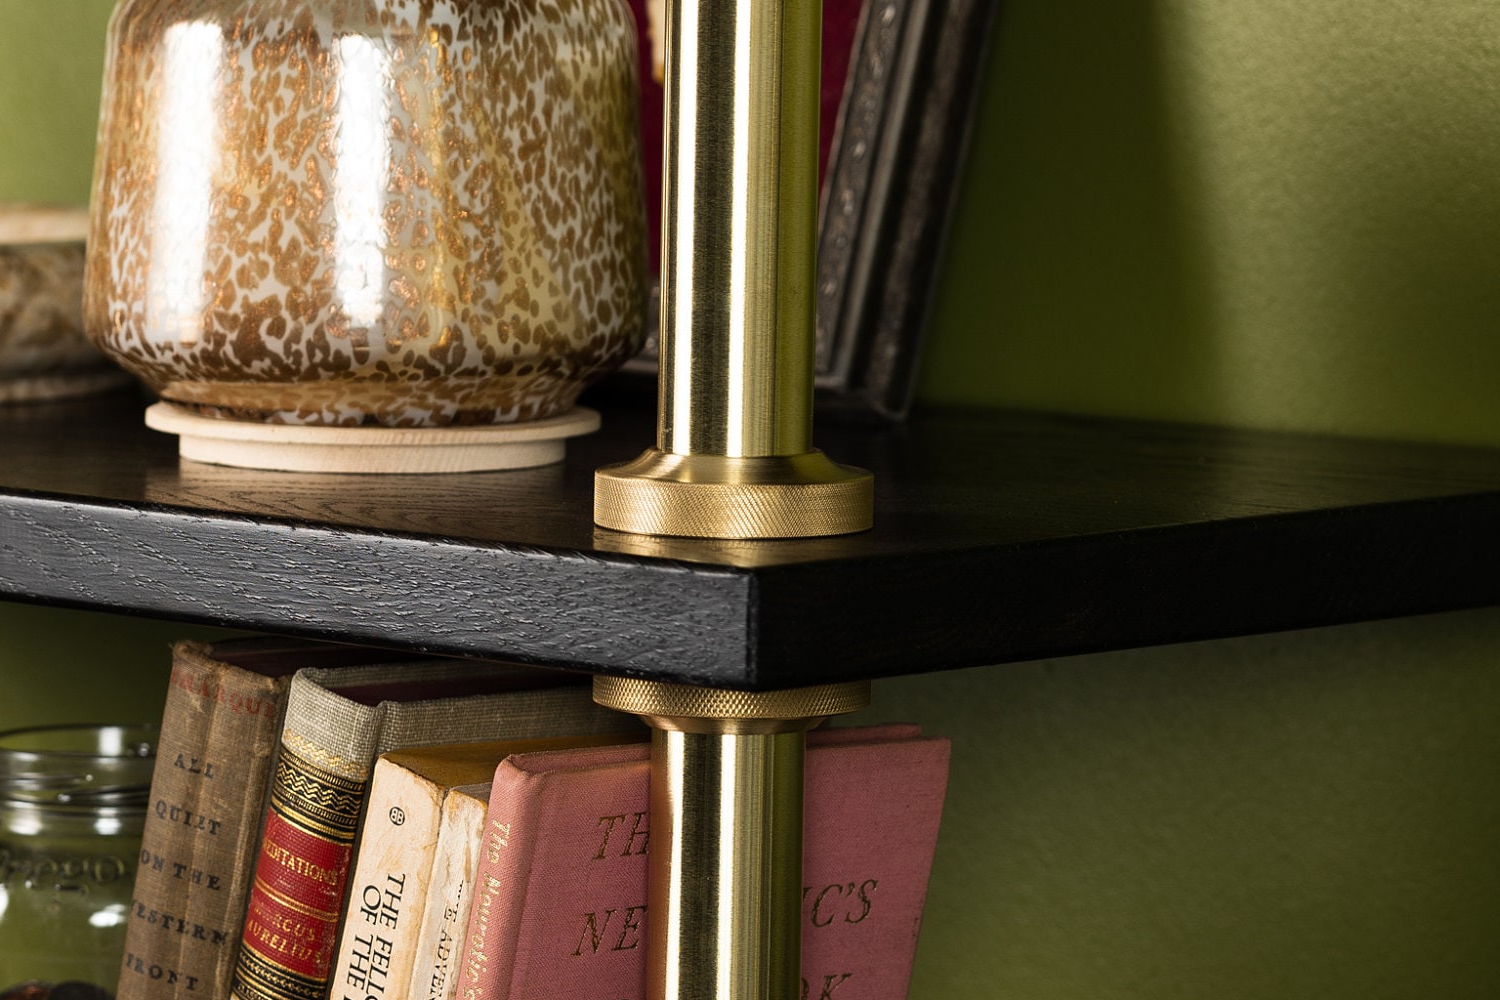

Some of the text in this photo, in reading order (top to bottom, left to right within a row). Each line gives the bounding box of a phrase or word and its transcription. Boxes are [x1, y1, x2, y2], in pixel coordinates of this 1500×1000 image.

[174, 752, 214, 779] ALL
[155, 799, 221, 836] QUIET
[592, 812, 651, 861] TH
[262, 836, 339, 886] EDITATIONS
[487, 819, 511, 864] The
[140, 849, 221, 891] ON THE
[360, 885, 382, 926] OF
[377, 873, 406, 930] THE
[134, 902, 228, 946] ESTERN
[125, 953, 199, 991] FRONT
[347, 934, 373, 991] THE
